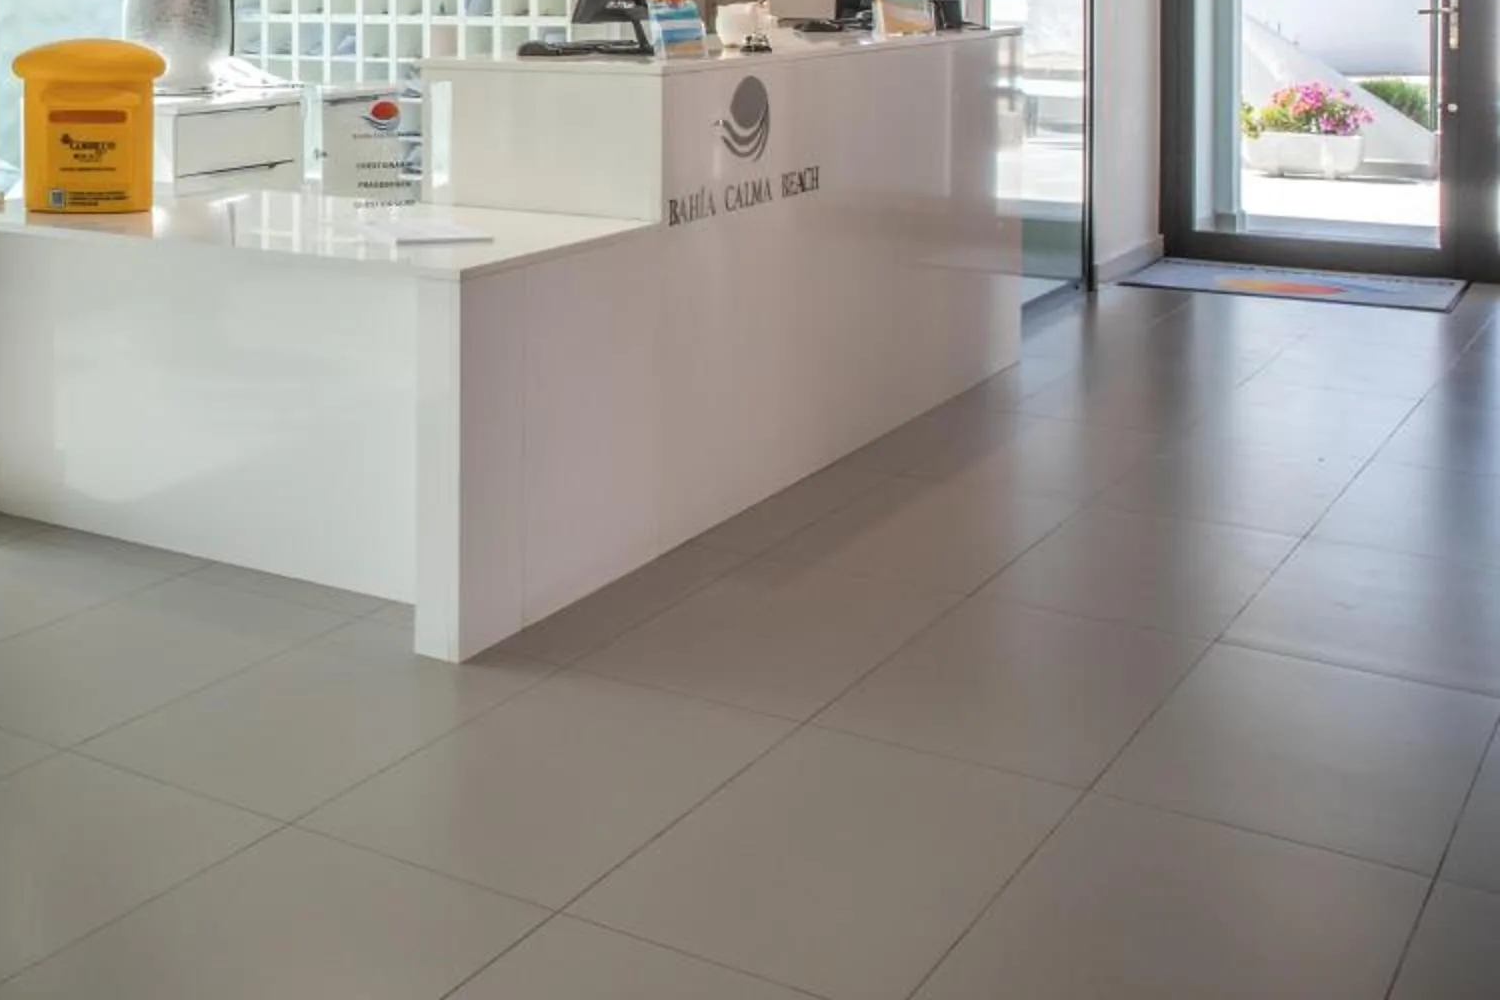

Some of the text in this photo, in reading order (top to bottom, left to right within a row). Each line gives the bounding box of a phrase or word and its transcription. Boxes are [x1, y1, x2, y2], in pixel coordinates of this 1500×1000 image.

[668, 166, 820, 227] BAHÍA CALMA BEACH
